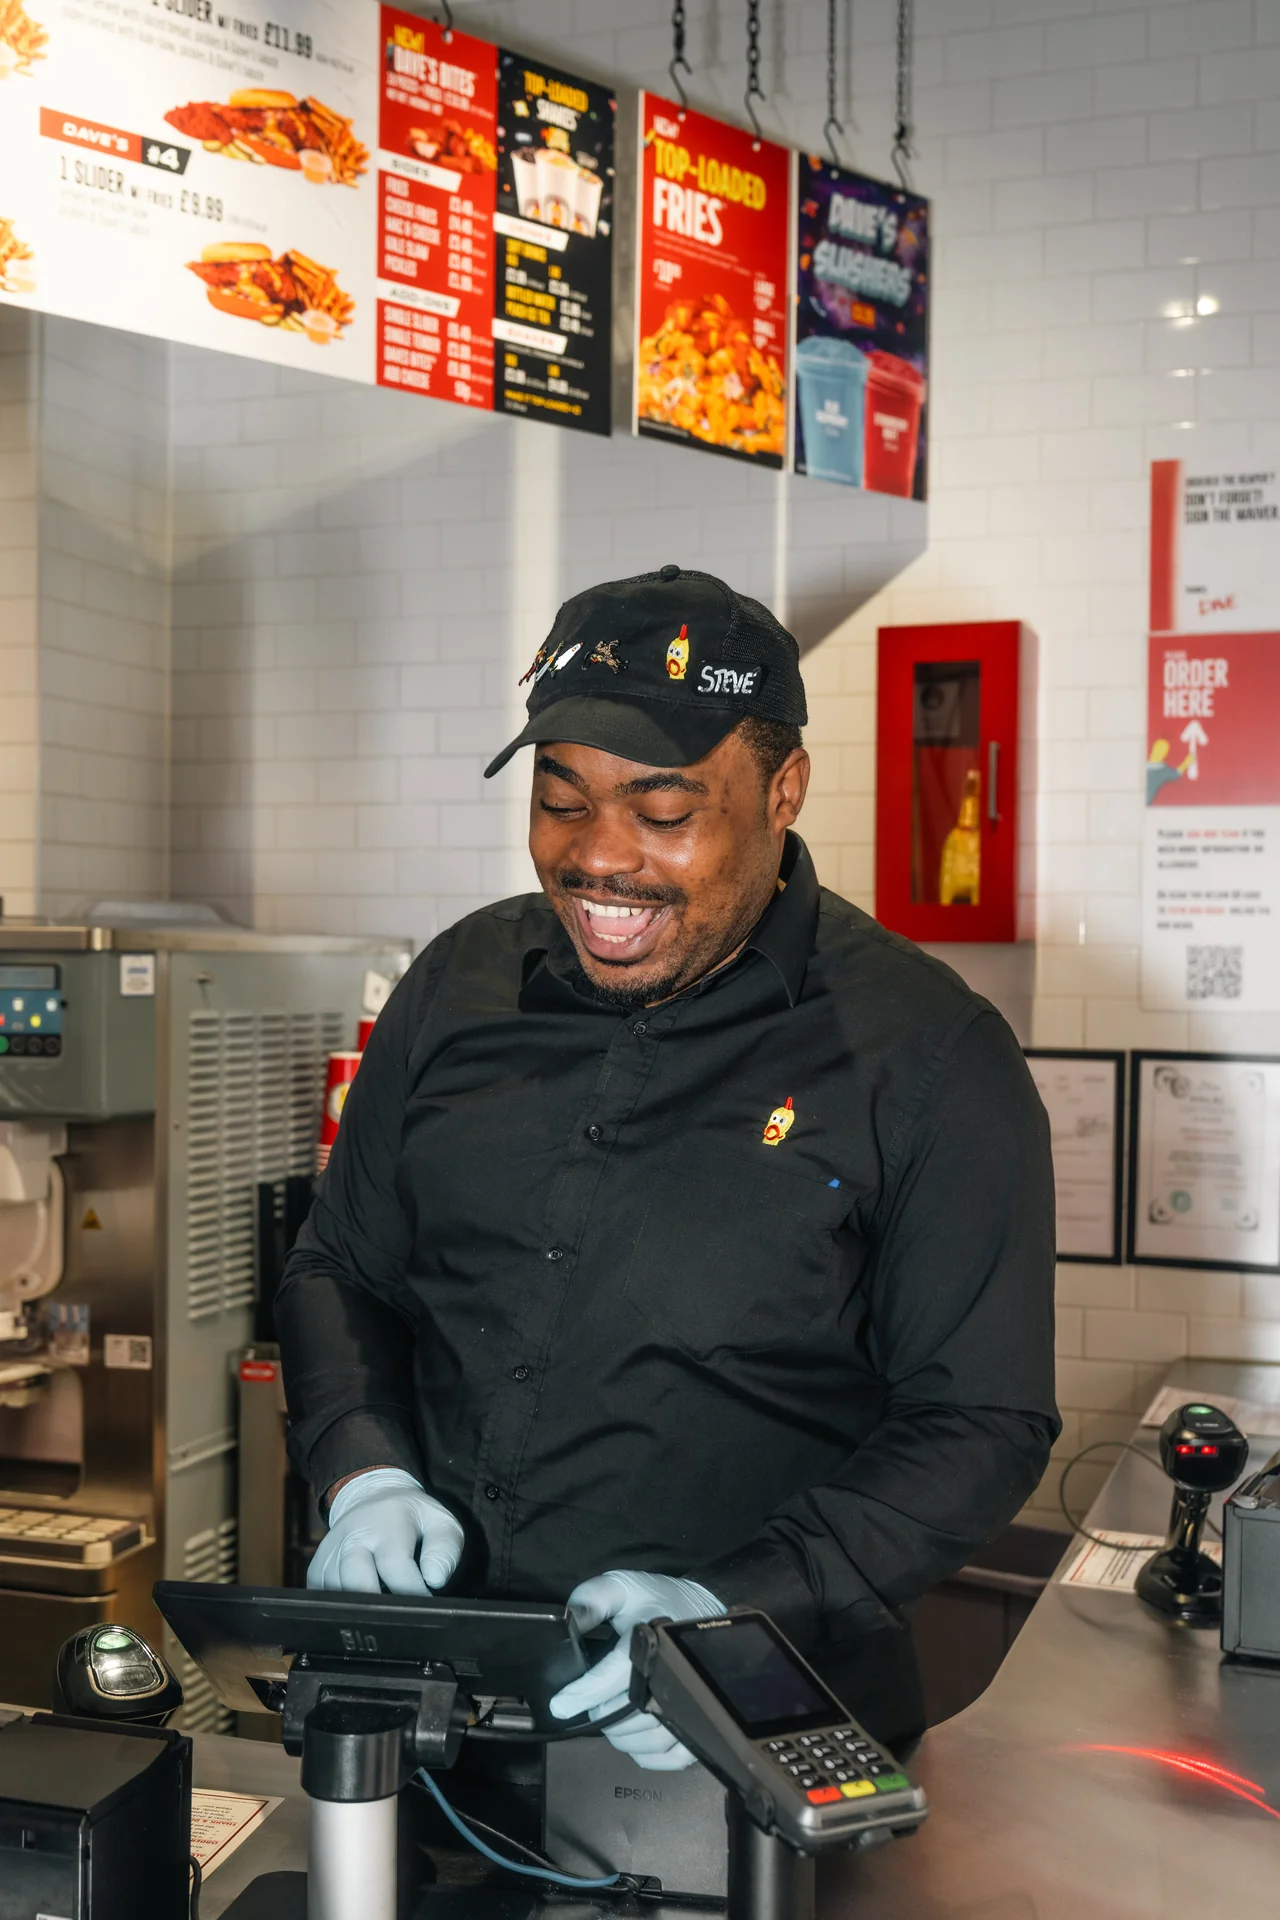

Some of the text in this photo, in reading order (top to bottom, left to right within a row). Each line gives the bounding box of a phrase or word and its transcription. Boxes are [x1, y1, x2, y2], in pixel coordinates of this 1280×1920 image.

[62, 121, 180, 171] DAVE'S #4
[61, 155, 67, 181] 1
[74, 160, 124, 195] SLIDER
[180, 189, 224, 222] £9.99
[654, 137, 767, 211] TOP-LOADED
[653, 177, 723, 247] FRIES
[829, 191, 898, 252] DAVE'S
[1213, 508, 1231, 523] THE
[697, 665, 755, 694] STEVE
[1163, 658, 1229, 689] ORDER
[1163, 687, 1215, 718] HERE
[614, 1786, 662, 1802] EPSON
